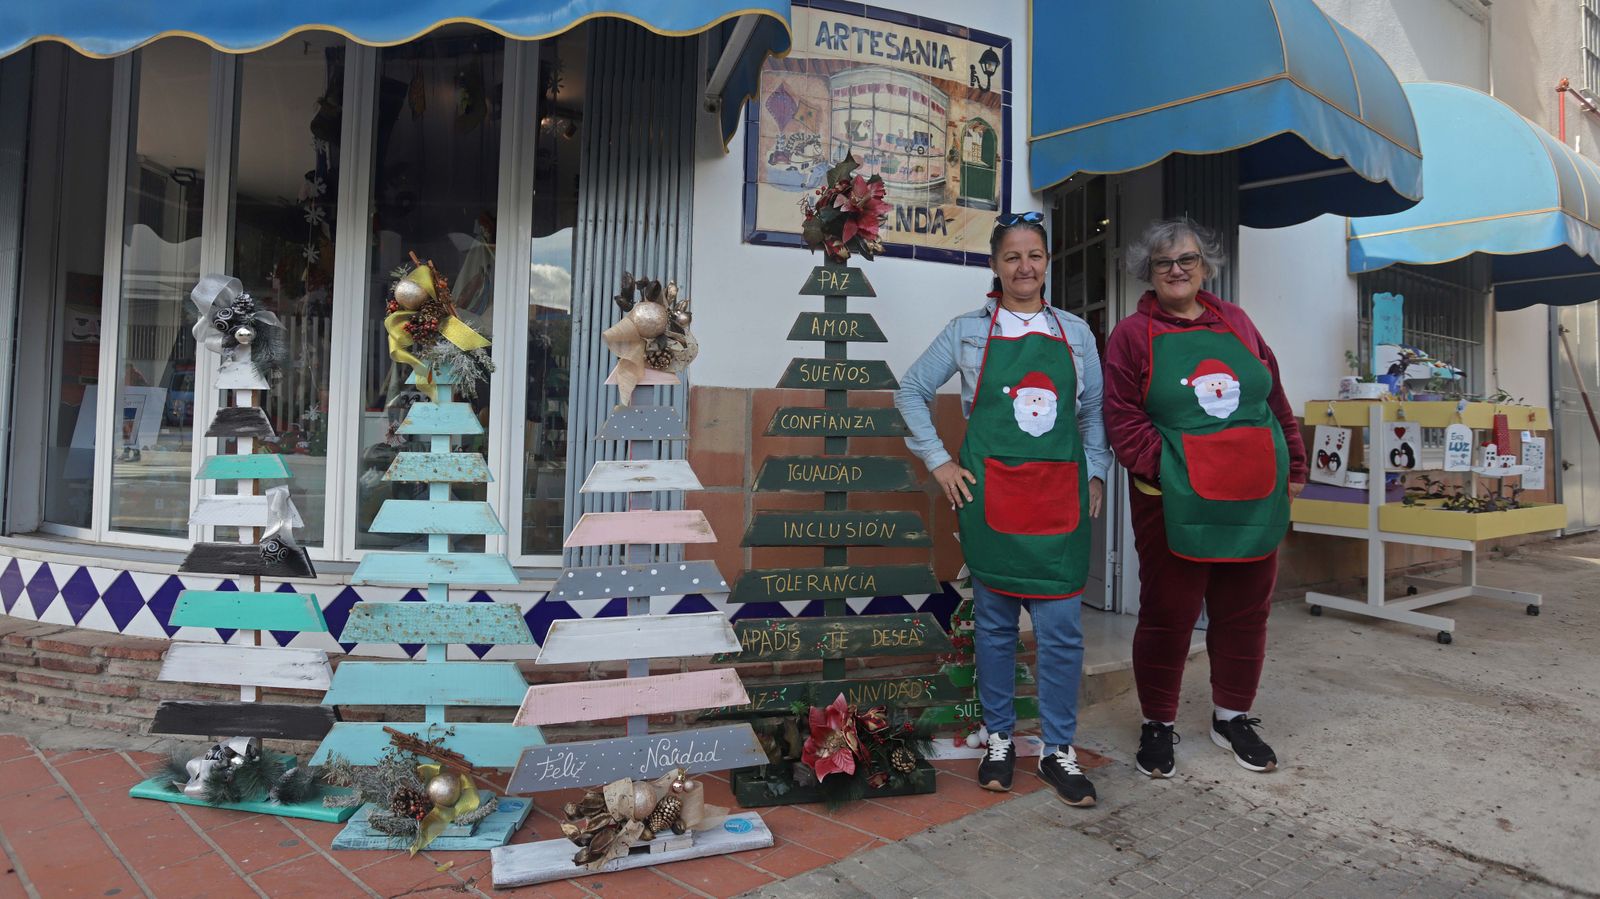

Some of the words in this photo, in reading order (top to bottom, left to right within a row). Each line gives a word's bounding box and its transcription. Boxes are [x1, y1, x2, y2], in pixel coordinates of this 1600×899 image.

[815, 20, 956, 72] ARTESANIA
[817, 270, 850, 291] PAZ
[811, 316, 864, 338] AMOR
[800, 362, 870, 384] SUEÑOS
[780, 412, 875, 431] CONFIANZA
[1448, 442, 1470, 452] LUZ
[787, 463, 862, 484] IGUALDAD
[761, 572, 876, 595] TOLERANCIA
[737, 628, 801, 657] APADIS
[827, 631, 849, 650] TE
[872, 627, 920, 647] DESEA
[850, 678, 923, 704] NAVIDAD
[955, 703, 983, 718] SUE
[536, 751, 586, 781] Feliz
[640, 738, 722, 773] Navidad
